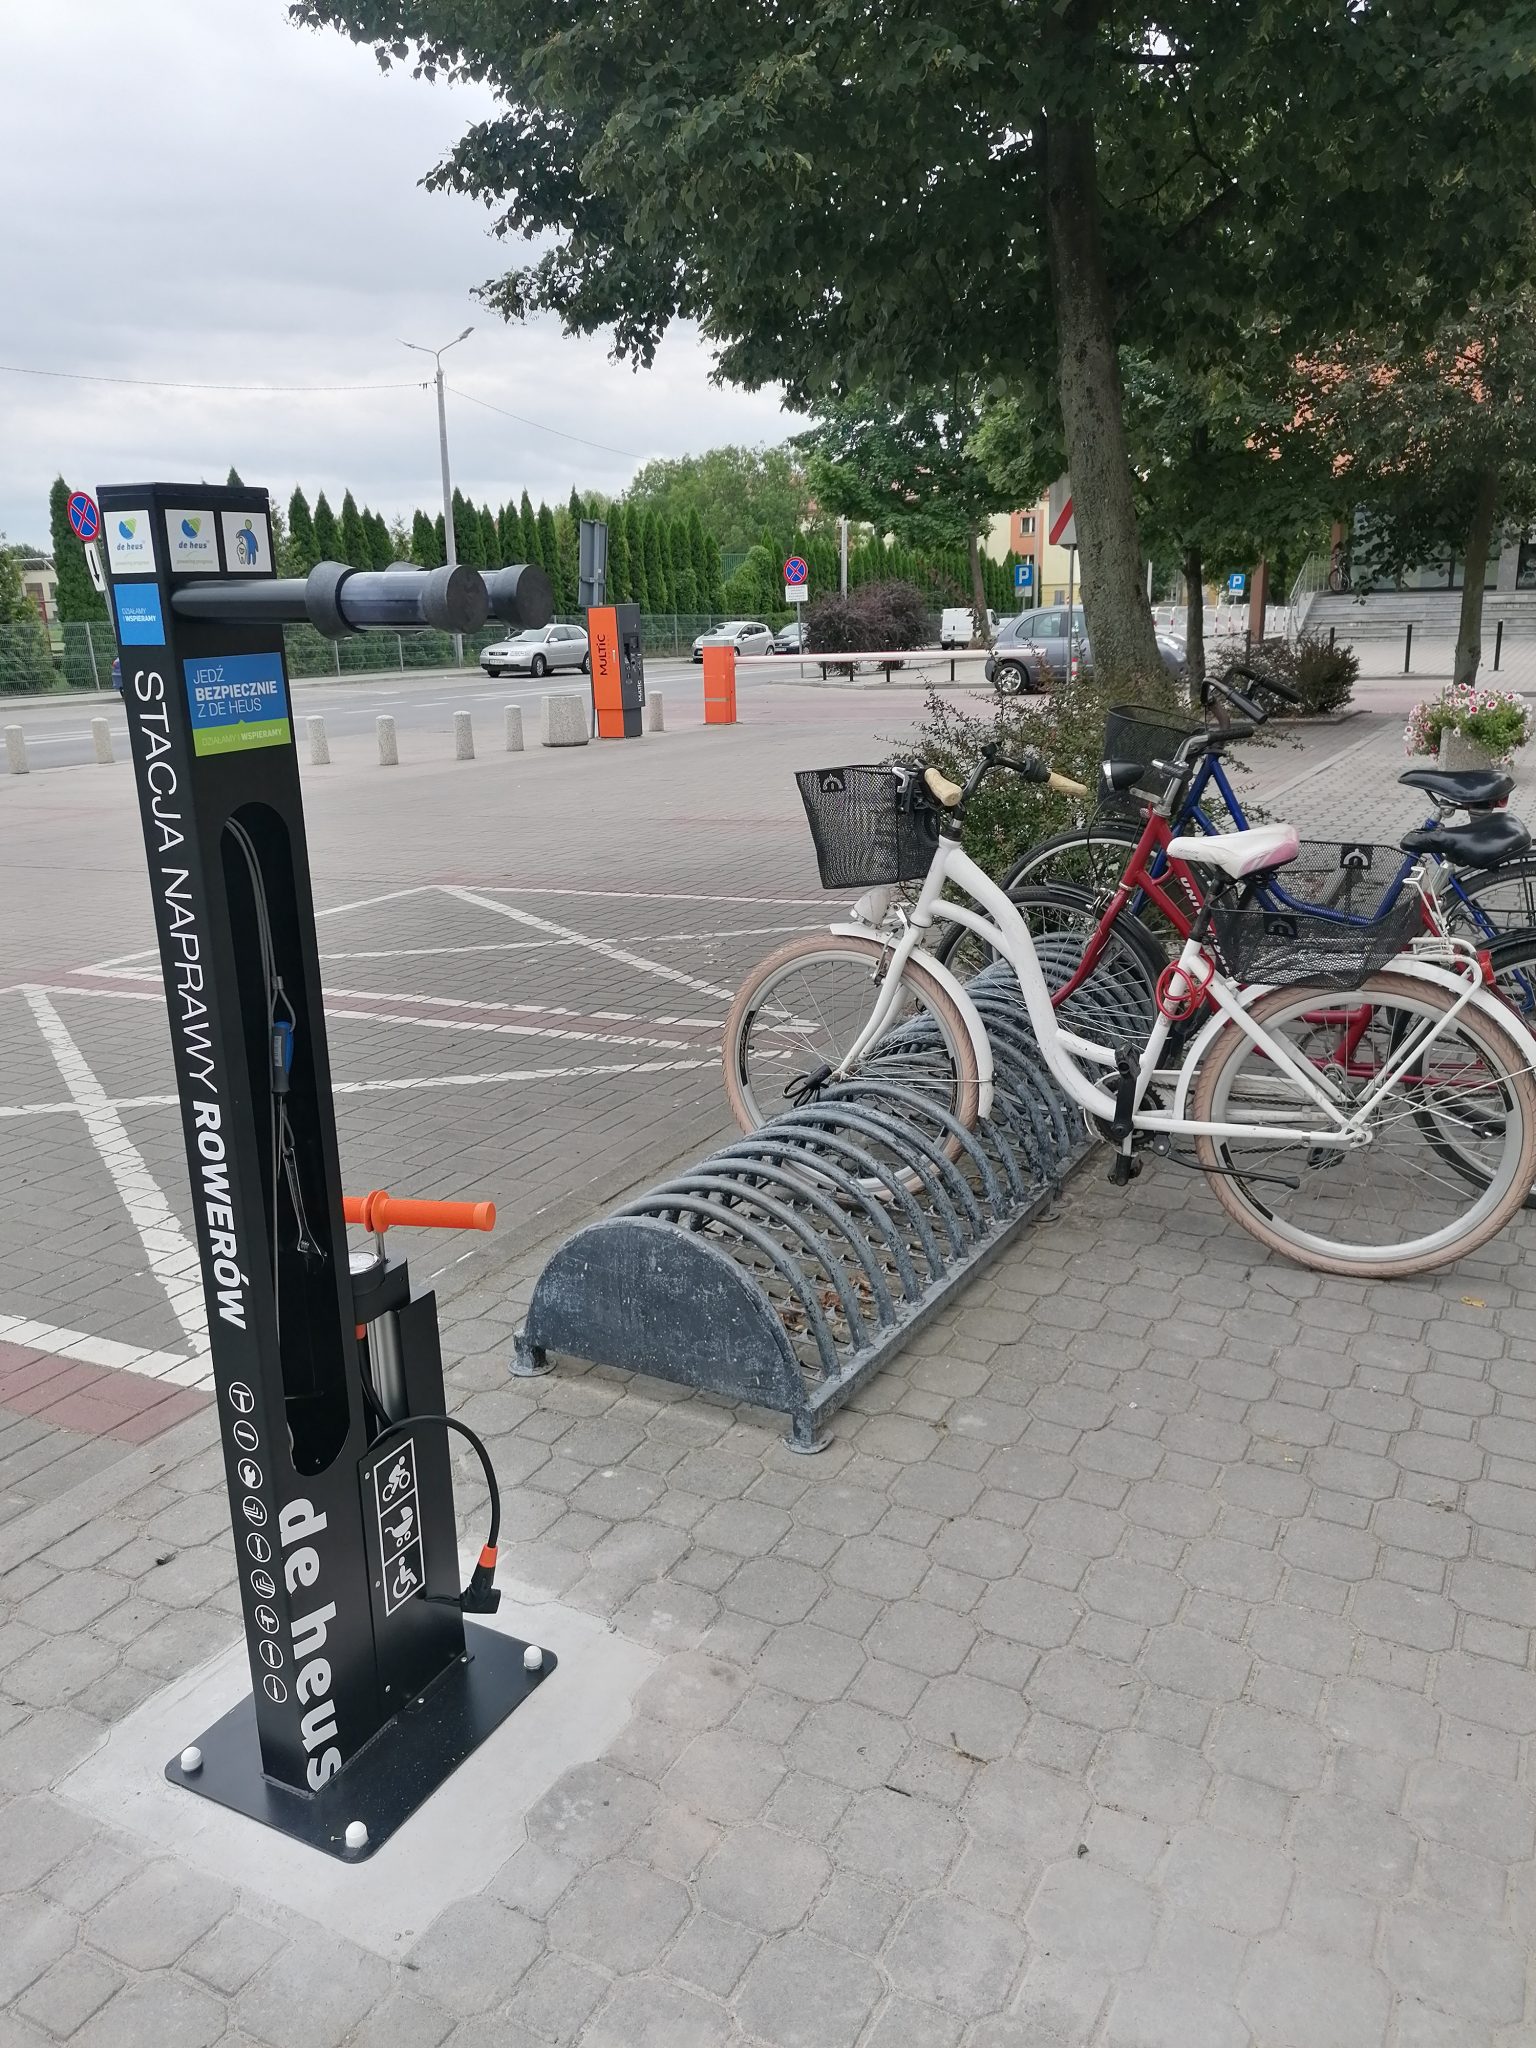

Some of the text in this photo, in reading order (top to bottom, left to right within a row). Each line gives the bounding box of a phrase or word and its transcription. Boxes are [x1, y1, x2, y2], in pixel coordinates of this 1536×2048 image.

[117, 542, 143, 551] de heus
[178, 540, 207, 549] de heus
[1018, 567, 1030, 584] P
[1232, 575, 1242, 588] P
[193, 664, 225, 685] JEDŹ
[195, 680, 278, 702] BEZPIECZNIE
[197, 697, 262, 718] Z DE HEUS
[240, 728, 282, 741] WSPIERAMY
[135, 670, 250, 1330] STACJA NAPRAWY ROWERÓW
[278, 1498, 342, 1792] de heus
